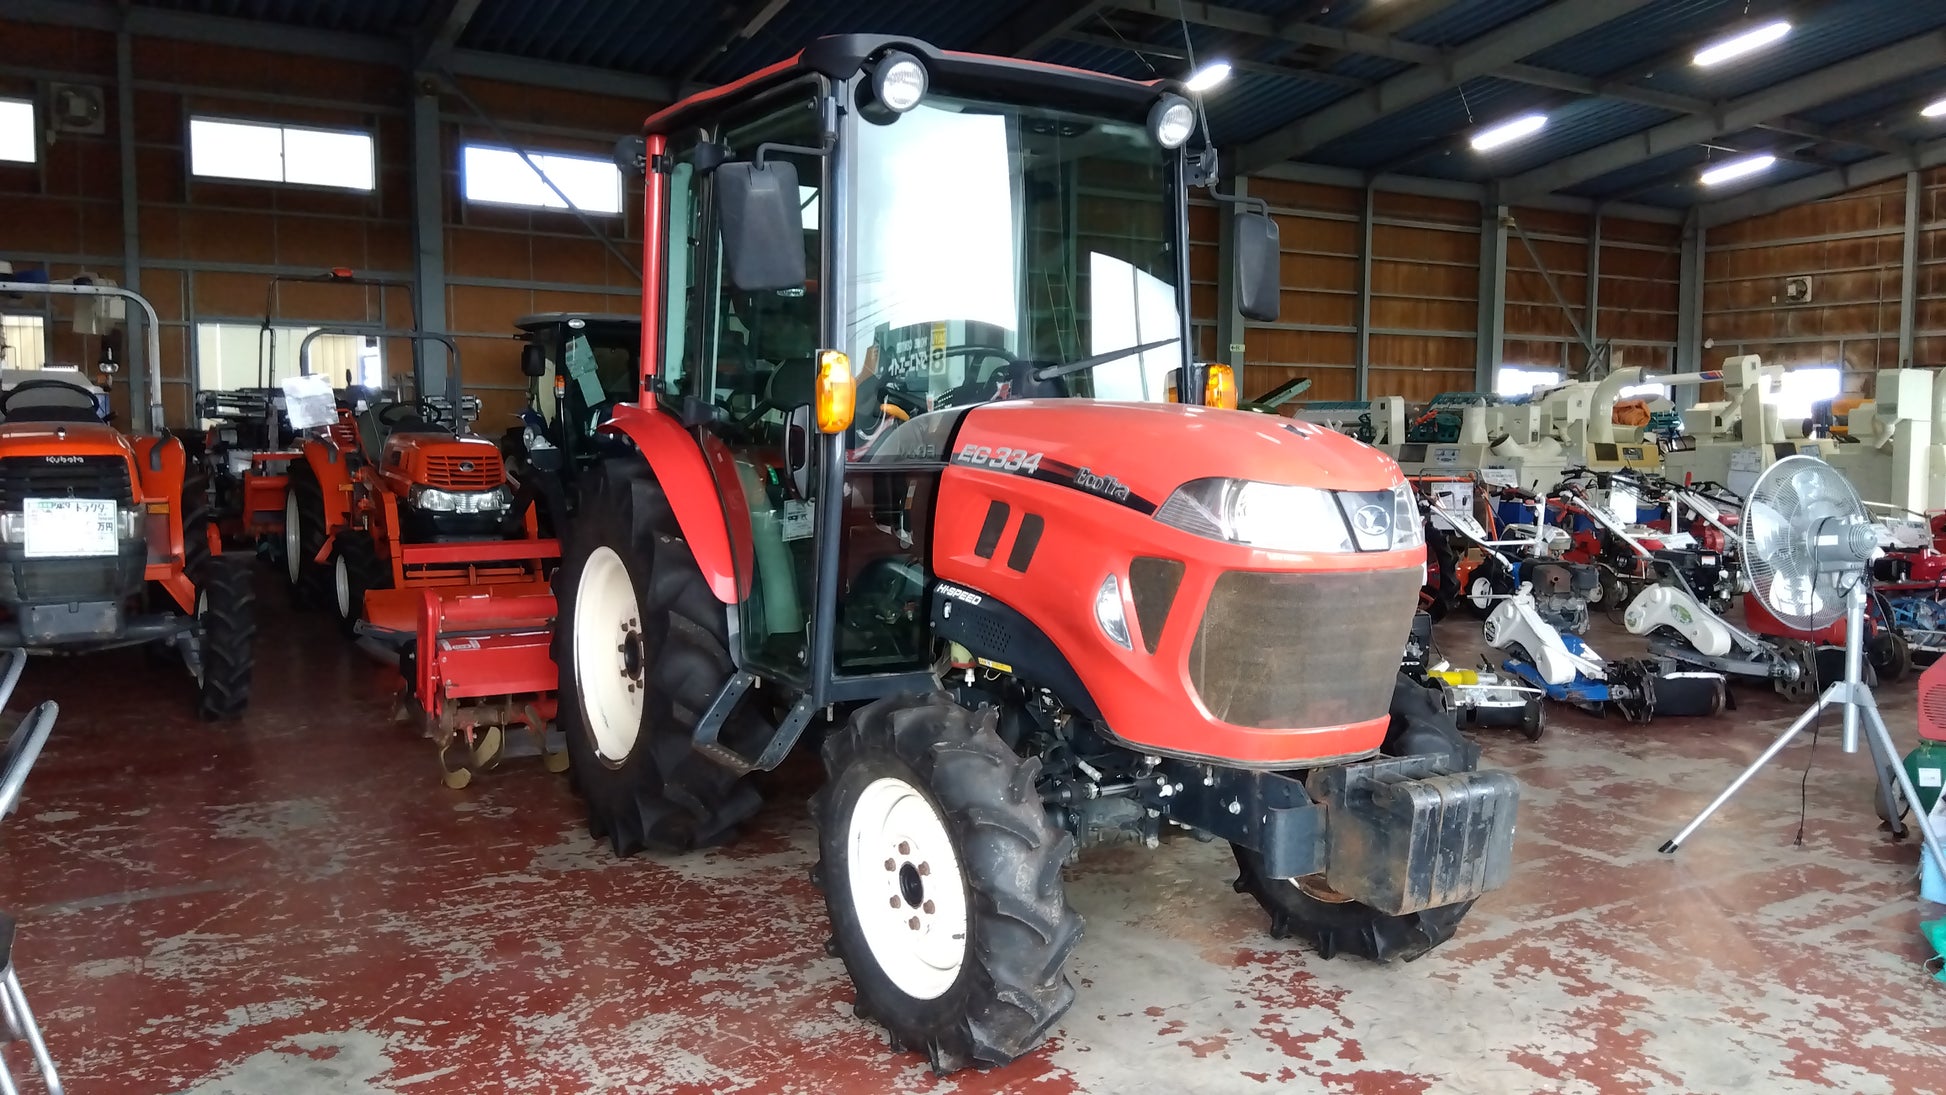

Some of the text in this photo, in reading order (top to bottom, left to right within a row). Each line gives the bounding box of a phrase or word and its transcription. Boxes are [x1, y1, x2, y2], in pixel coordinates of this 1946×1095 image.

[45, 456, 85, 464] Kubota
[957, 444, 991, 464] EG
[989, 446, 1045, 475] 334
[1074, 466, 1131, 501] EcoTra
[936, 583, 982, 606] HI-SPEED
